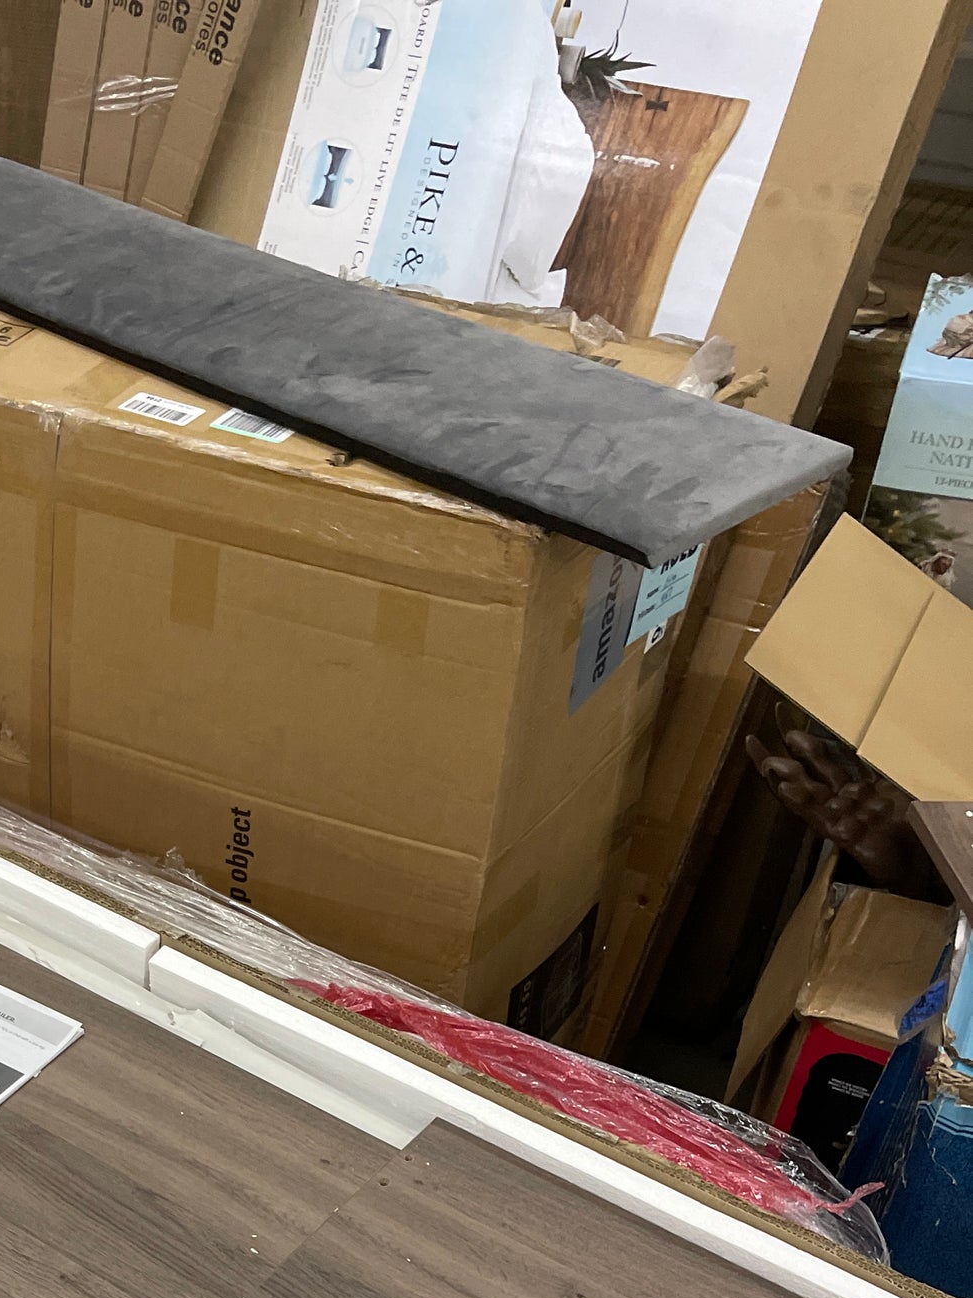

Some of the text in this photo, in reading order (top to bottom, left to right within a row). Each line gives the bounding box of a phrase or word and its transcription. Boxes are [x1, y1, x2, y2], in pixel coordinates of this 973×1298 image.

[392, 108, 406, 125] DE
[383, 132, 401, 154] LIT
[373, 161, 390, 191] LIVE
[361, 198, 380, 233] EDGE
[399, 137, 460, 275] PIKE &
[909, 430, 964, 450] HAND
[226, 806, 255, 883] object
